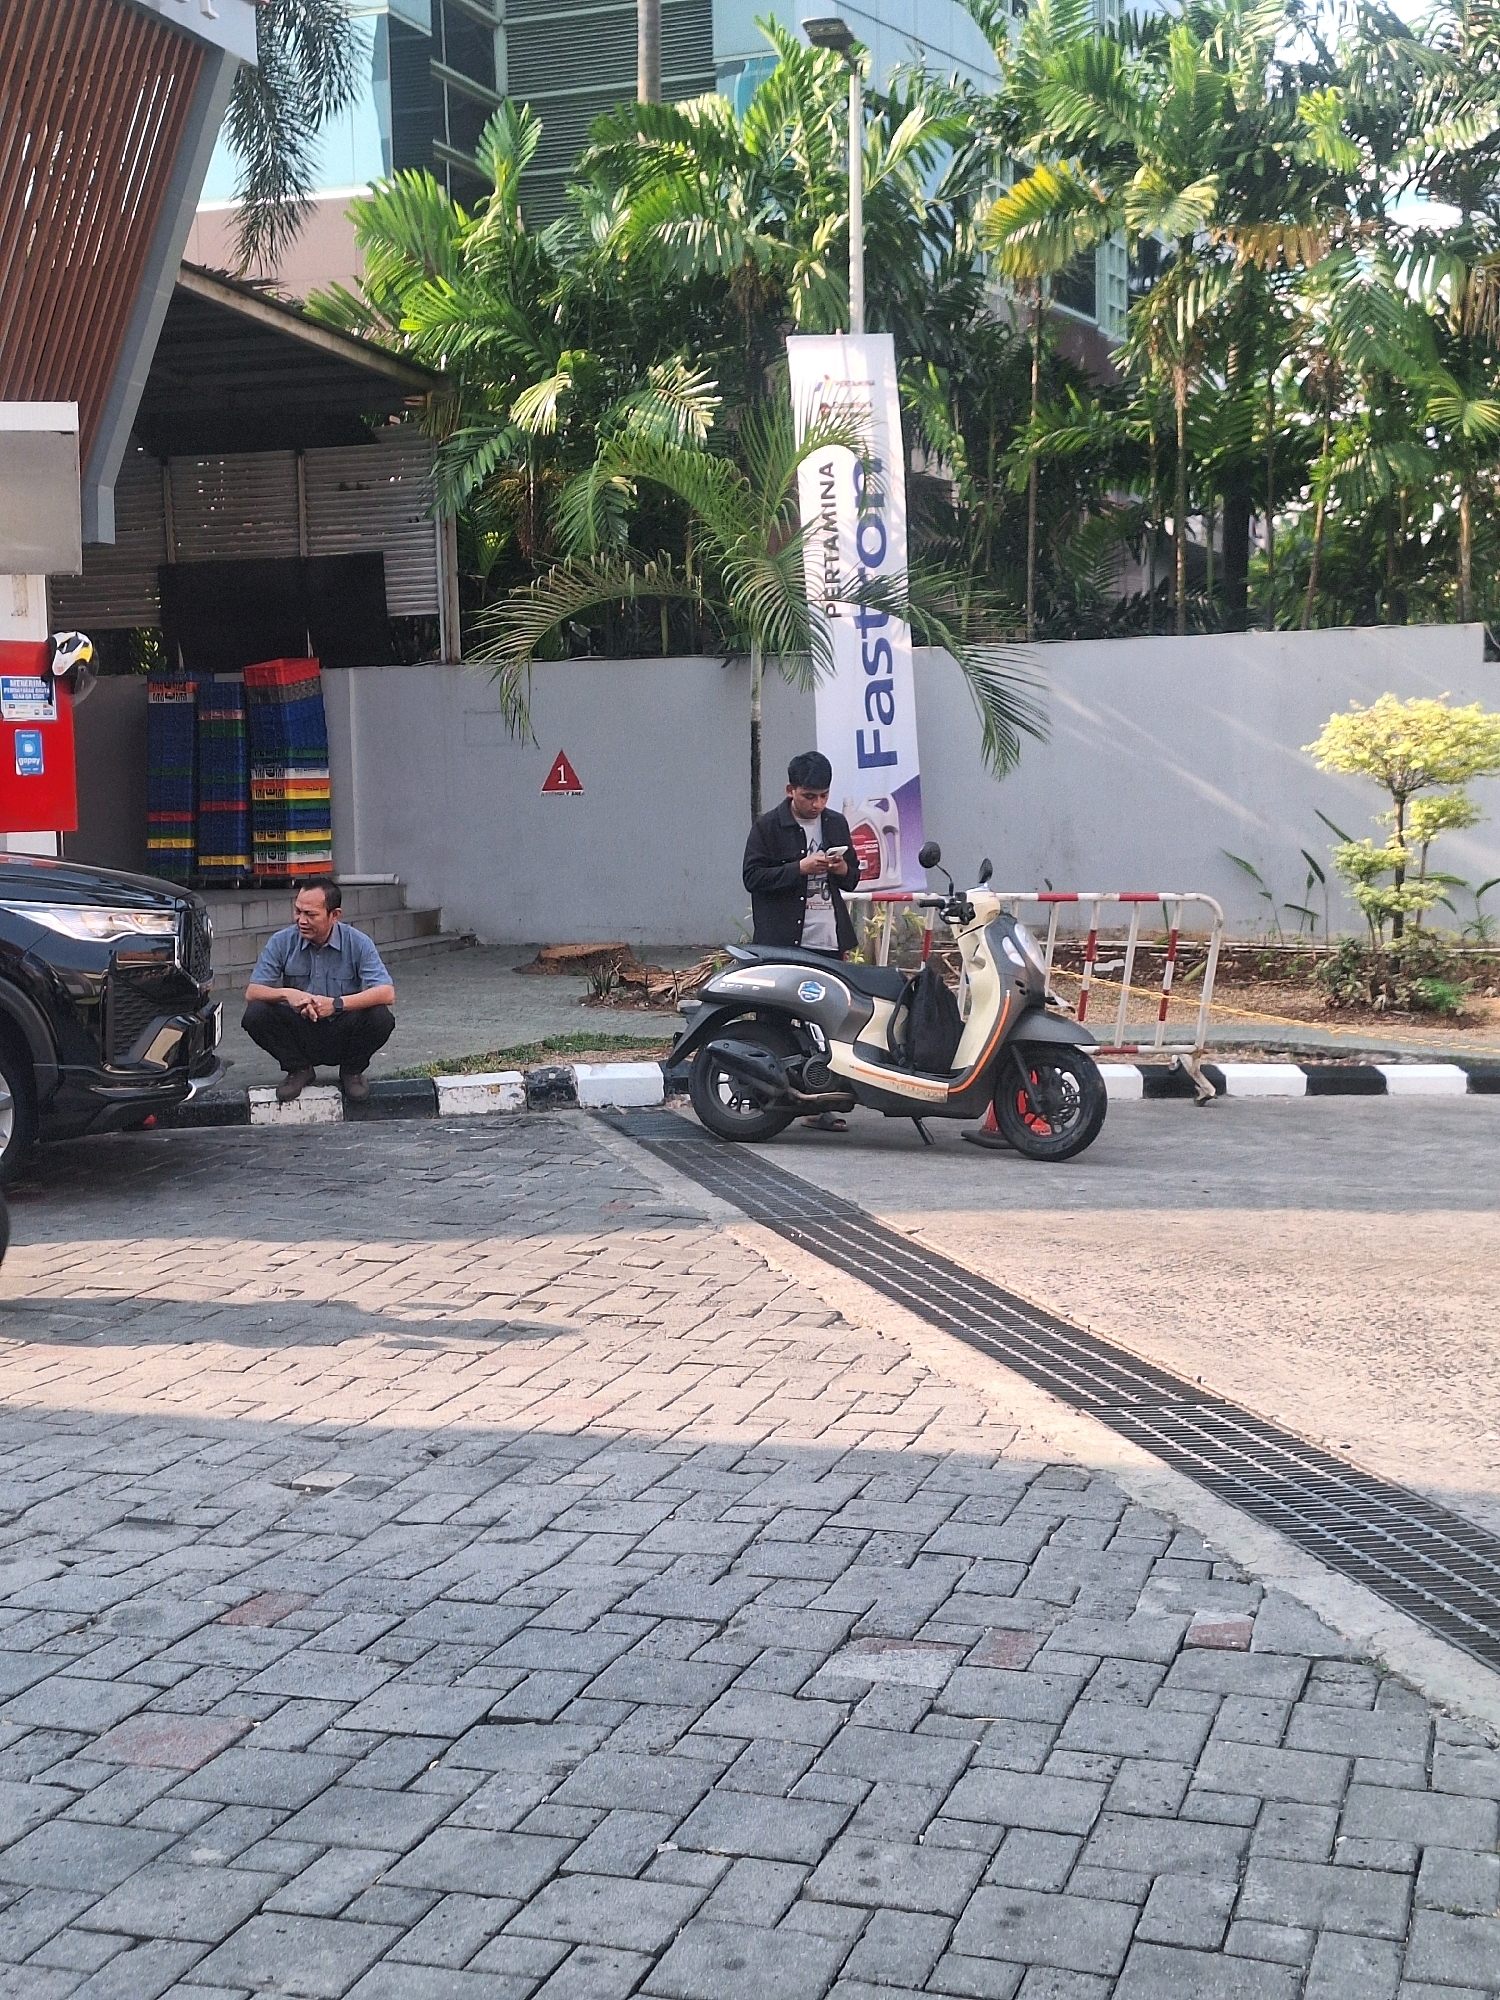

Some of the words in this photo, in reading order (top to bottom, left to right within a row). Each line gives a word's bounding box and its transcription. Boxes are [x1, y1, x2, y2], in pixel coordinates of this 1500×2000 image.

[818, 461, 842, 618] PERTAMINA
[18, 757, 41, 766] gopay
[557, 764, 568, 784] 1
